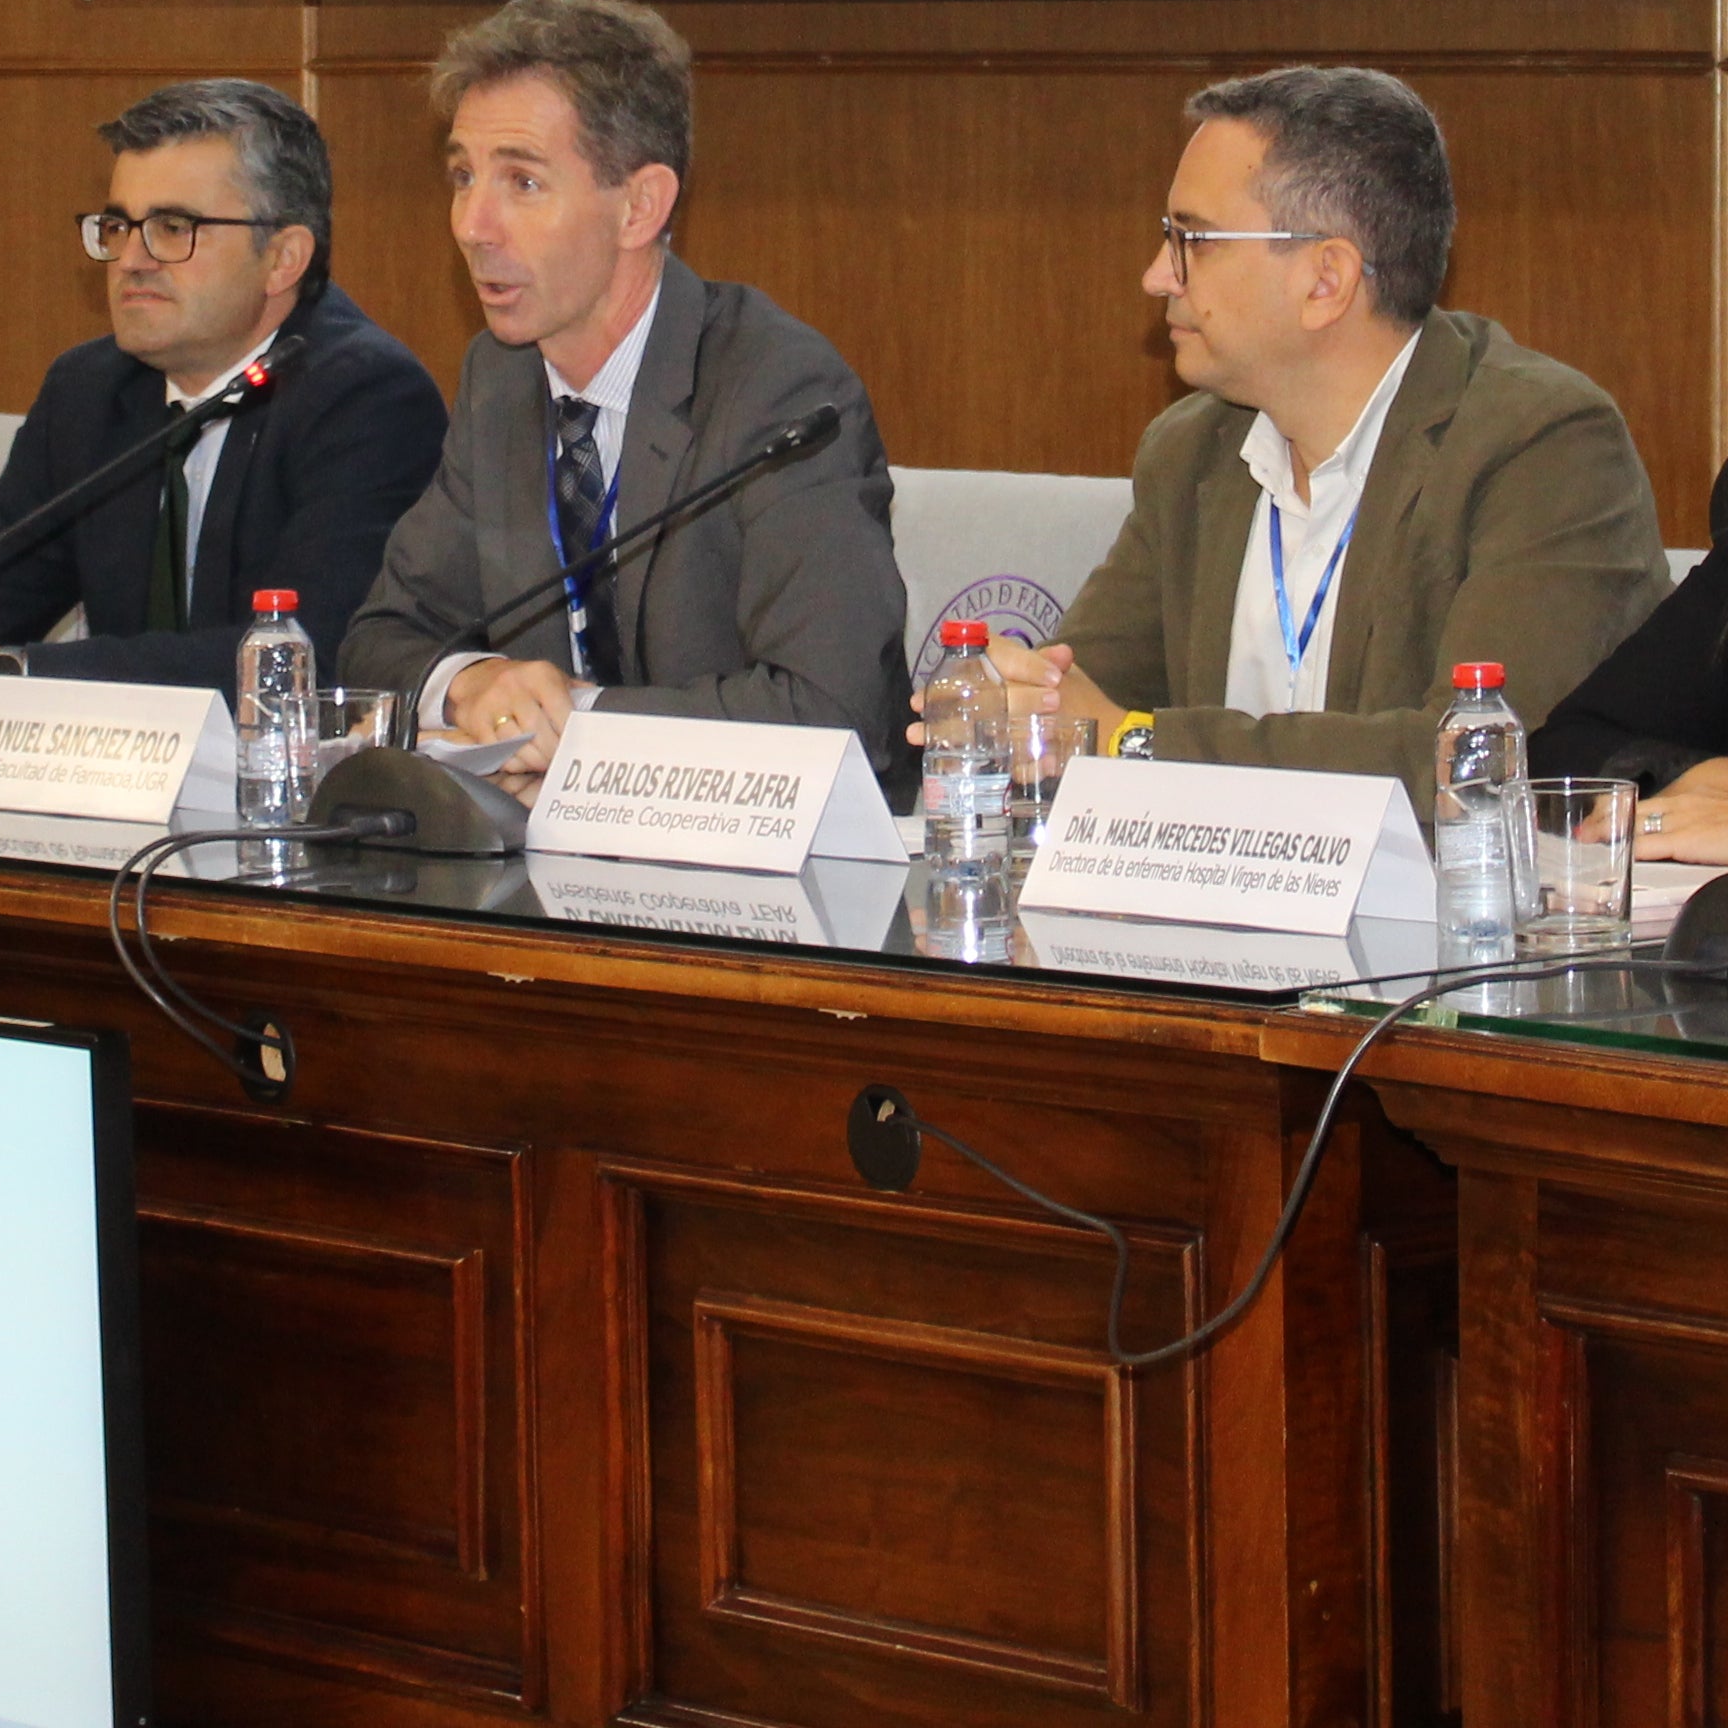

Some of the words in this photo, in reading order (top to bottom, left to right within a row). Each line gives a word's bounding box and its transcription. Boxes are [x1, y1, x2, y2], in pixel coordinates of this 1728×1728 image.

[130, 731, 180, 764] POLO
[47, 763, 67, 783] de
[561, 758, 580, 792] D.
[585, 761, 665, 799] CARLOS
[659, 766, 738, 804] RIVERA
[734, 771, 801, 810] ZAFRA
[546, 799, 634, 825] Presidente
[637, 806, 740, 835] Cooperativa
[746, 815, 796, 840] TEAR
[1103, 812, 1153, 847] MARÍA
[1152, 822, 1228, 855] MERCEDES
[1227, 827, 1300, 861] VILLEGAS
[1299, 833, 1351, 866] CALVO
[1048, 851, 1097, 874] Directora
[1097, 856, 1113, 876] de
[1183, 864, 1227, 889] Hospital
[1229, 865, 1267, 893] Virgen
[1266, 868, 1282, 890] de
[1283, 870, 1300, 893] las
[1302, 873, 1341, 898] Nieves
